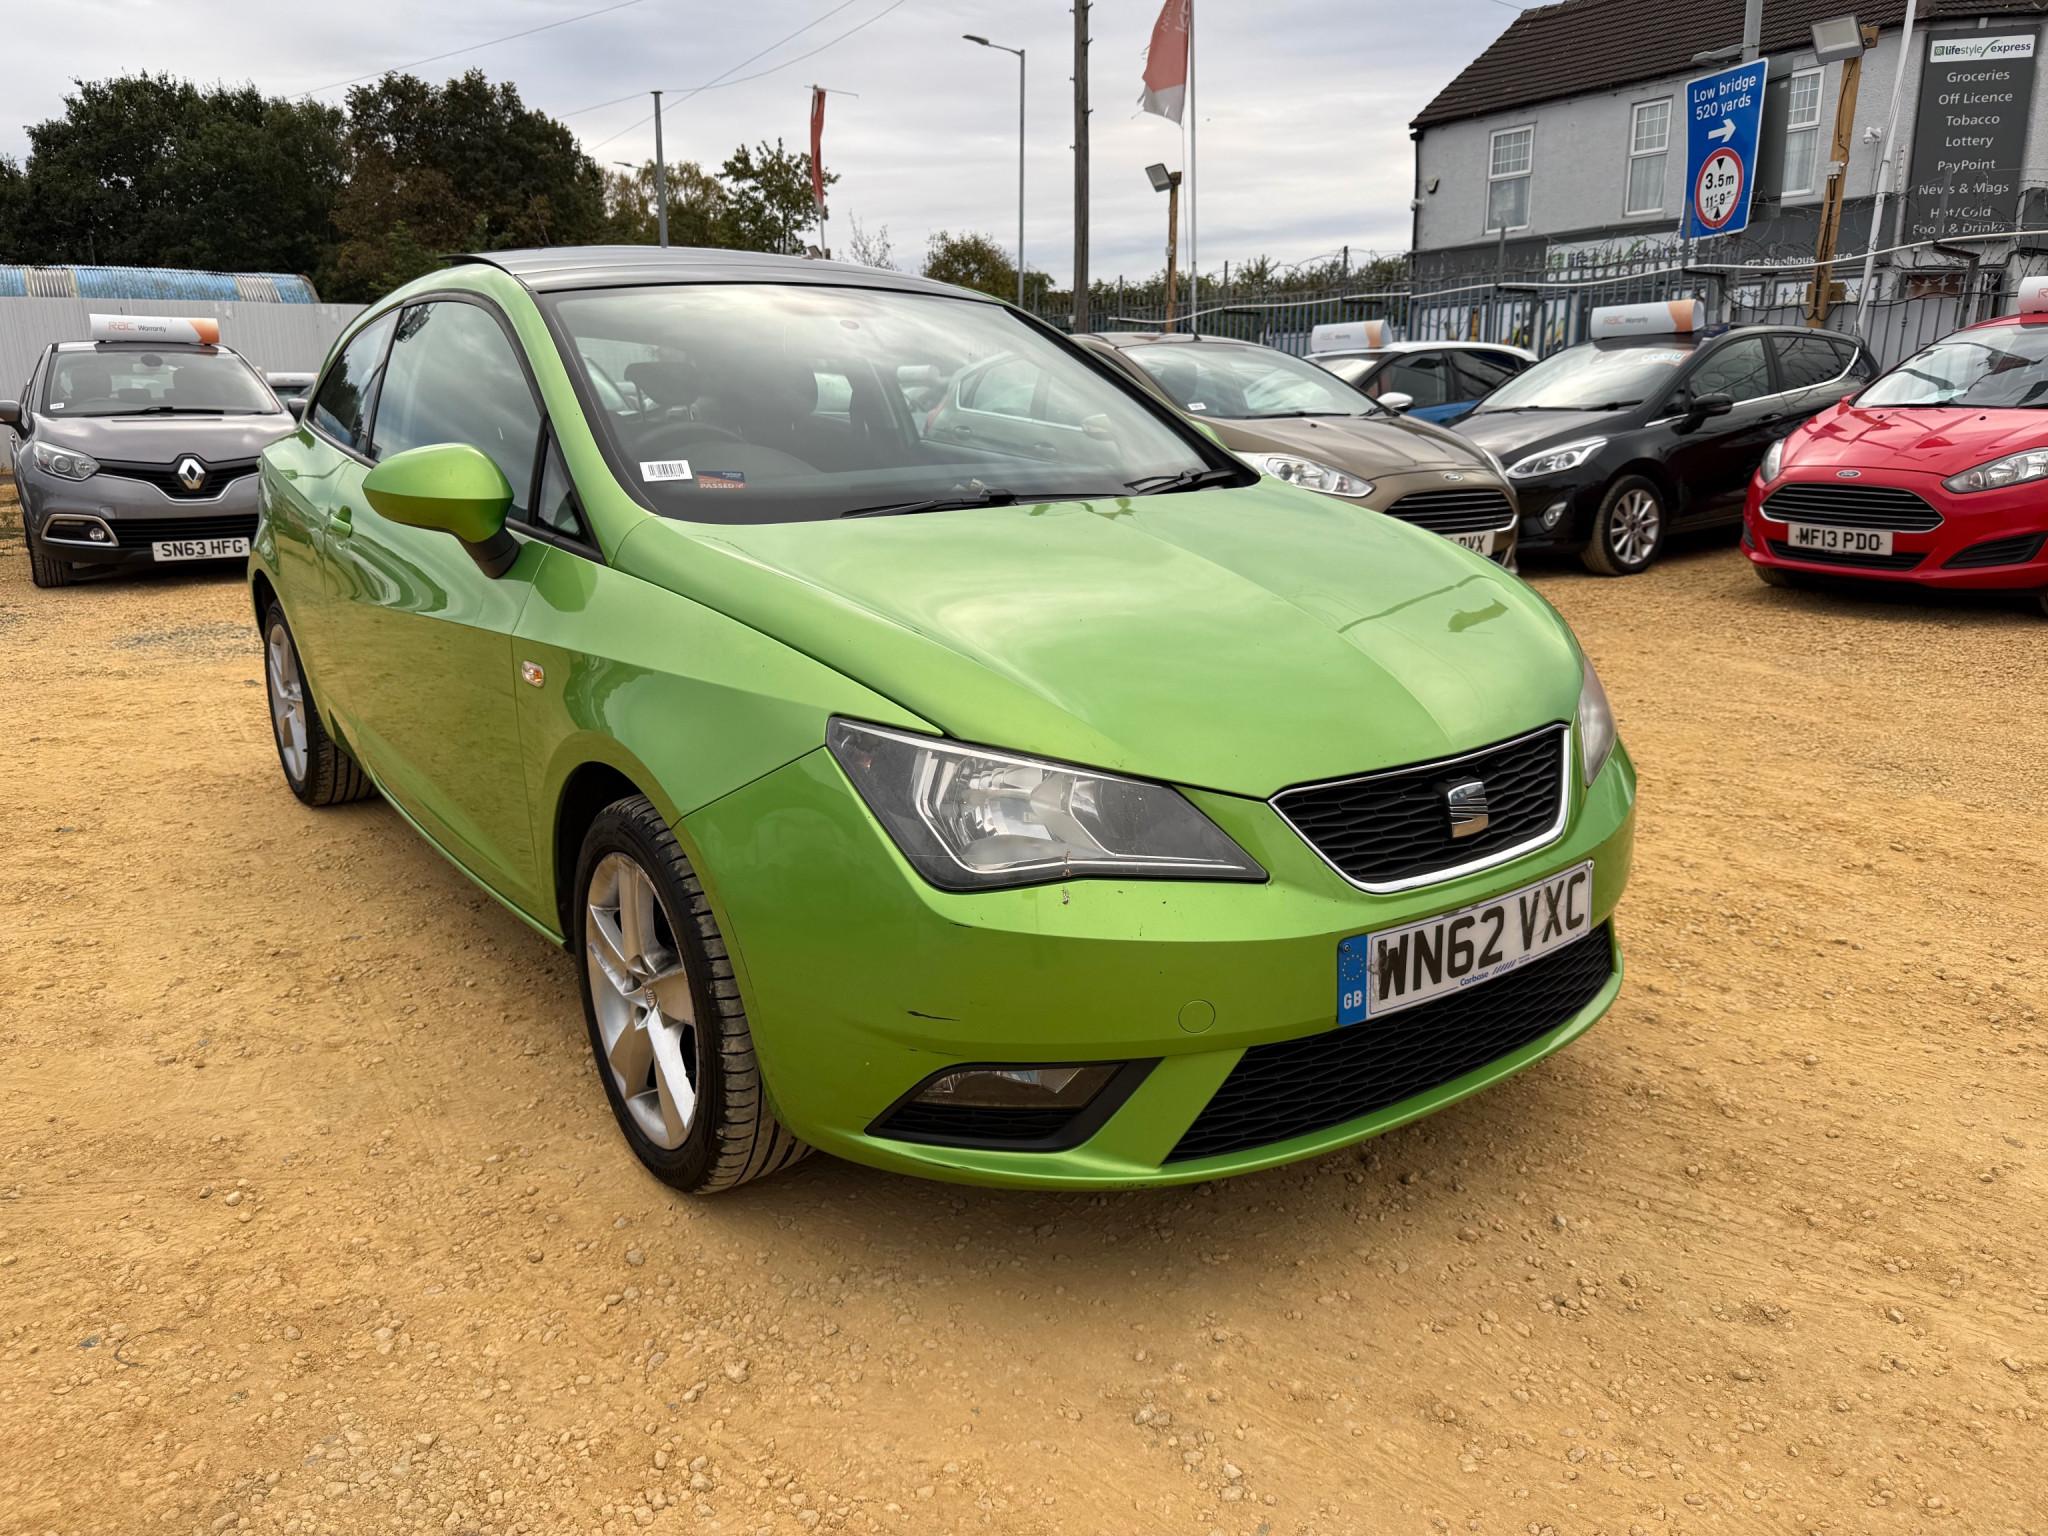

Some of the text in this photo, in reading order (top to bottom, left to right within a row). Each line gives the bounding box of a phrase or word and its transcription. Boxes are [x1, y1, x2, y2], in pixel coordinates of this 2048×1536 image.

[1945, 43, 2031, 56] lifestyle express
[1946, 69, 2010, 83] Groceries
[1694, 75, 1757, 103] Low bridge
[1938, 92, 2013, 105] Off Licence
[1696, 93, 1752, 120] 520 yards
[1945, 114, 2001, 127] Tobacco
[1945, 136, 1994, 149] Lottery
[1937, 158, 1996, 173] PayPoint
[1959, 183, 1969, 194] &
[1973, 182, 2009, 195] Mags
[1948, 223, 1959, 234] &
[1962, 221, 2005, 233] Drinks
[1763, 255, 1816, 267] Steelhous
[138, 325, 166, 333] Warranty
[1799, 528, 1880, 551] MF13 PDO
[161, 540, 243, 557] SN63 HFG
[1377, 871, 1586, 1001] WN62 VXC
[1460, 972, 1489, 986] Carbase
[1343, 990, 1362, 1010] GB
